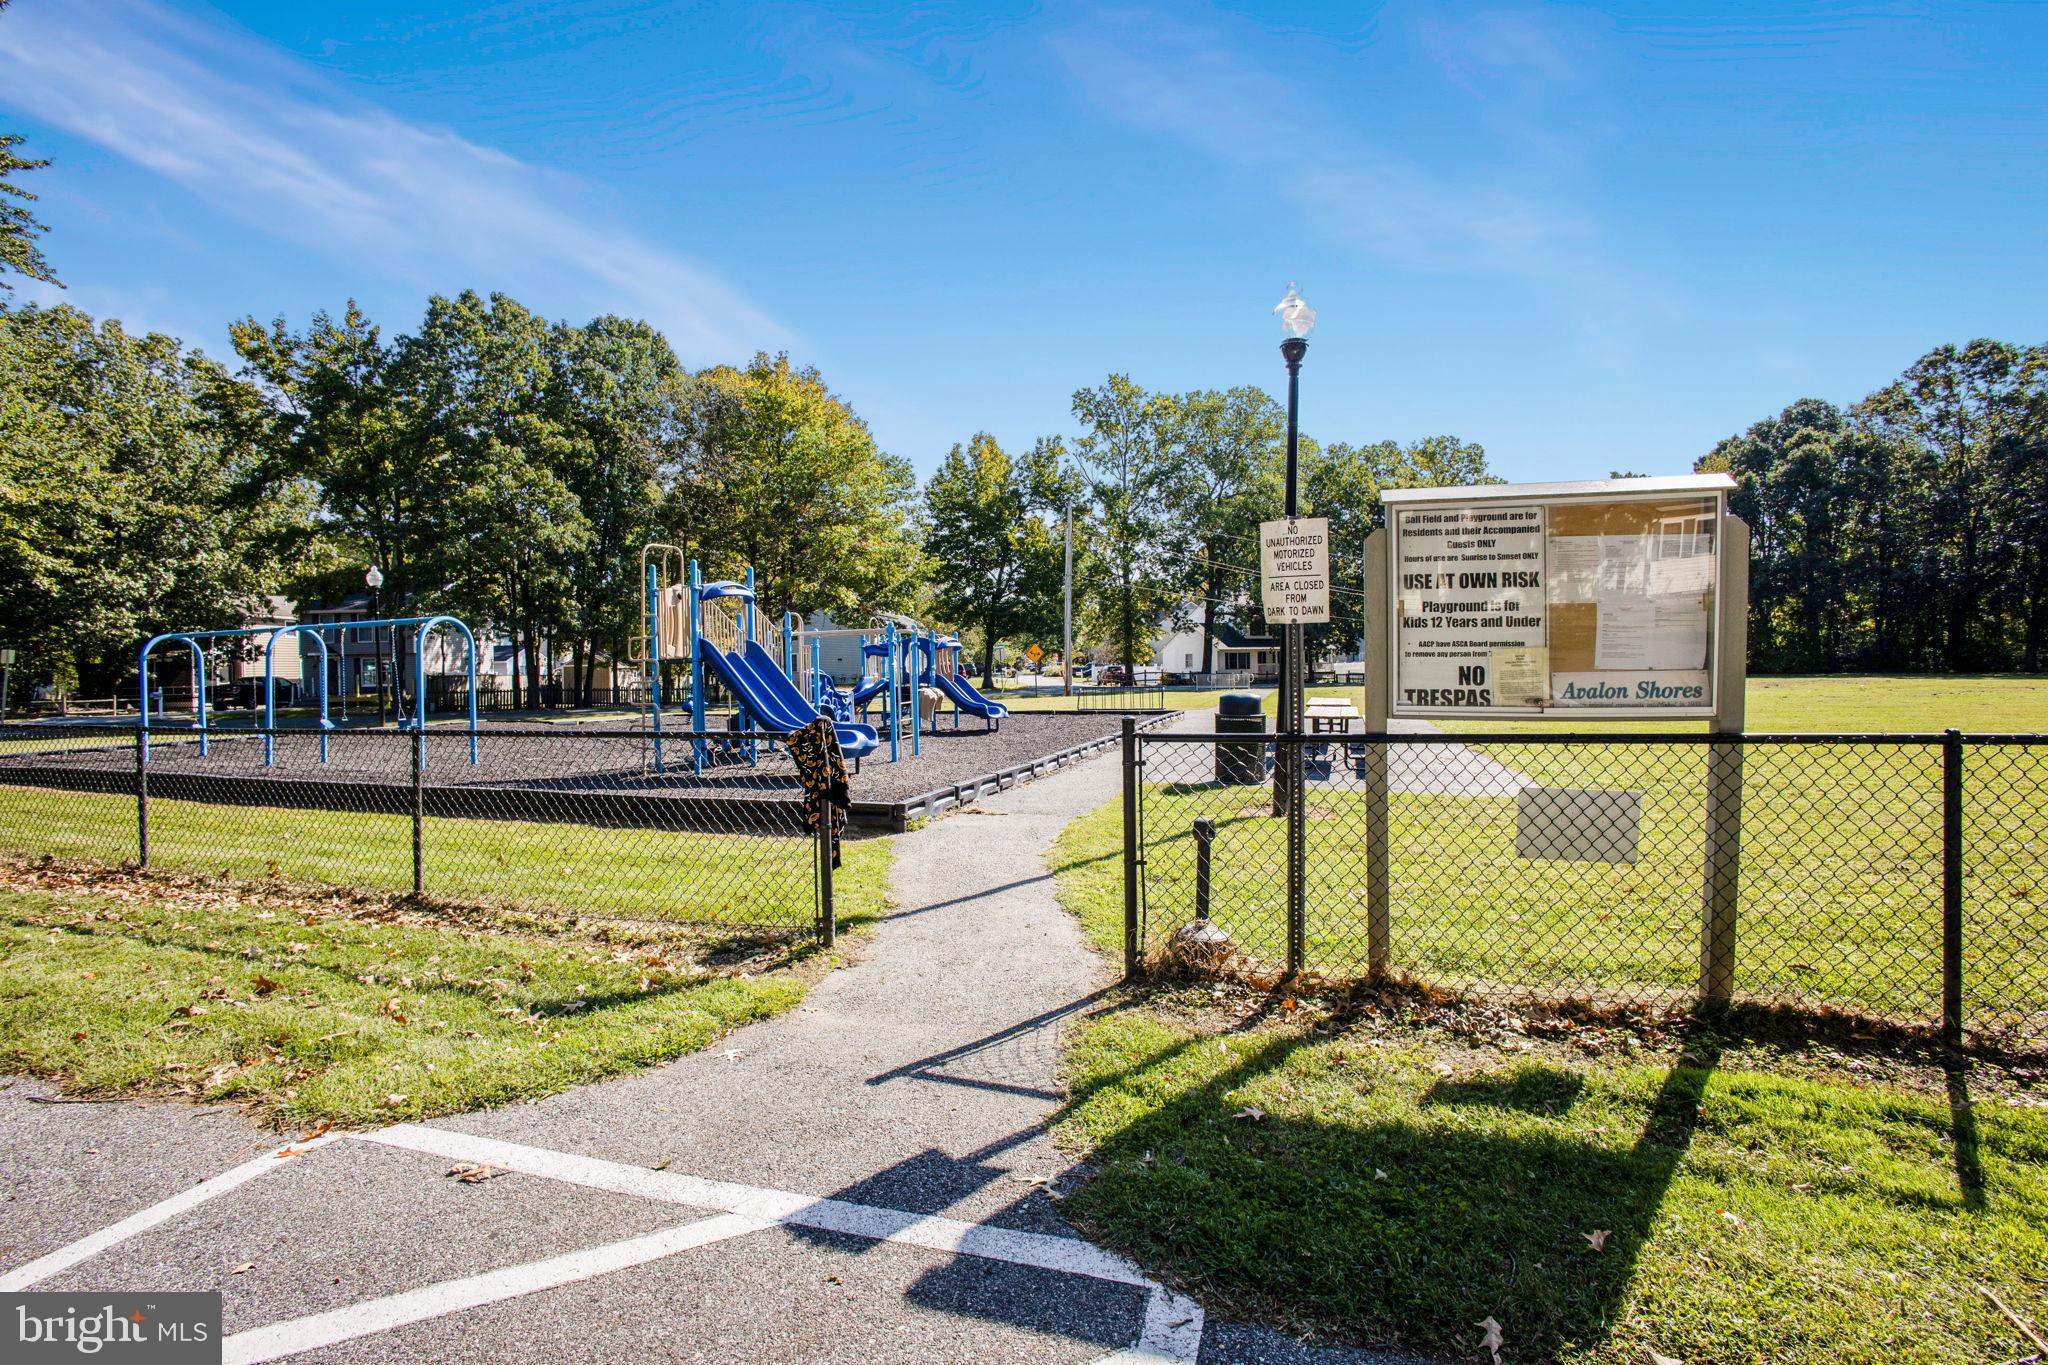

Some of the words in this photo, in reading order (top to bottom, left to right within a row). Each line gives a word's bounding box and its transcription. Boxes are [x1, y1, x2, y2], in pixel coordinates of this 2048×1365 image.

[1423, 515, 1442, 523] Field
[1444, 514, 1458, 522] and
[1525, 512, 1537, 520] for
[1287, 525, 1298, 534] NO
[1402, 528, 1442, 536] Residents
[1462, 527, 1481, 535] their
[1483, 525, 1540, 534] Accompanied
[1266, 536, 1323, 548] UNAUTHORIZED
[1447, 540, 1475, 548] Guests
[1274, 548, 1315, 559] MOTORIZED
[1277, 561, 1312, 571] VEHICLES
[1270, 582, 1290, 591] AREA
[1294, 581, 1324, 590] CLOSED
[1404, 574, 1432, 590] USE
[1436, 573, 1455, 589] AT
[1459, 573, 1497, 589] OWN
[1502, 571, 1540, 588] RISK
[1286, 594, 1307, 603] FROM
[1267, 608, 1285, 616] DARK
[1289, 606, 1298, 615] TO
[1302, 606, 1323, 615] DAWN
[1422, 601, 1488, 613] Playground
[1491, 600, 1501, 611] is
[1504, 600, 1520, 611] for
[1403, 617, 1428, 628] Kids
[1431, 617, 1443, 628] 12
[1445, 617, 1478, 628] Years
[1481, 616, 1503, 627] and
[1506, 616, 1541, 627] Under
[1489, 640, 1525, 648] permission
[1458, 666, 1485, 686] NO
[1560, 681, 1629, 699] Avalon
[1636, 680, 1703, 699] Shores
